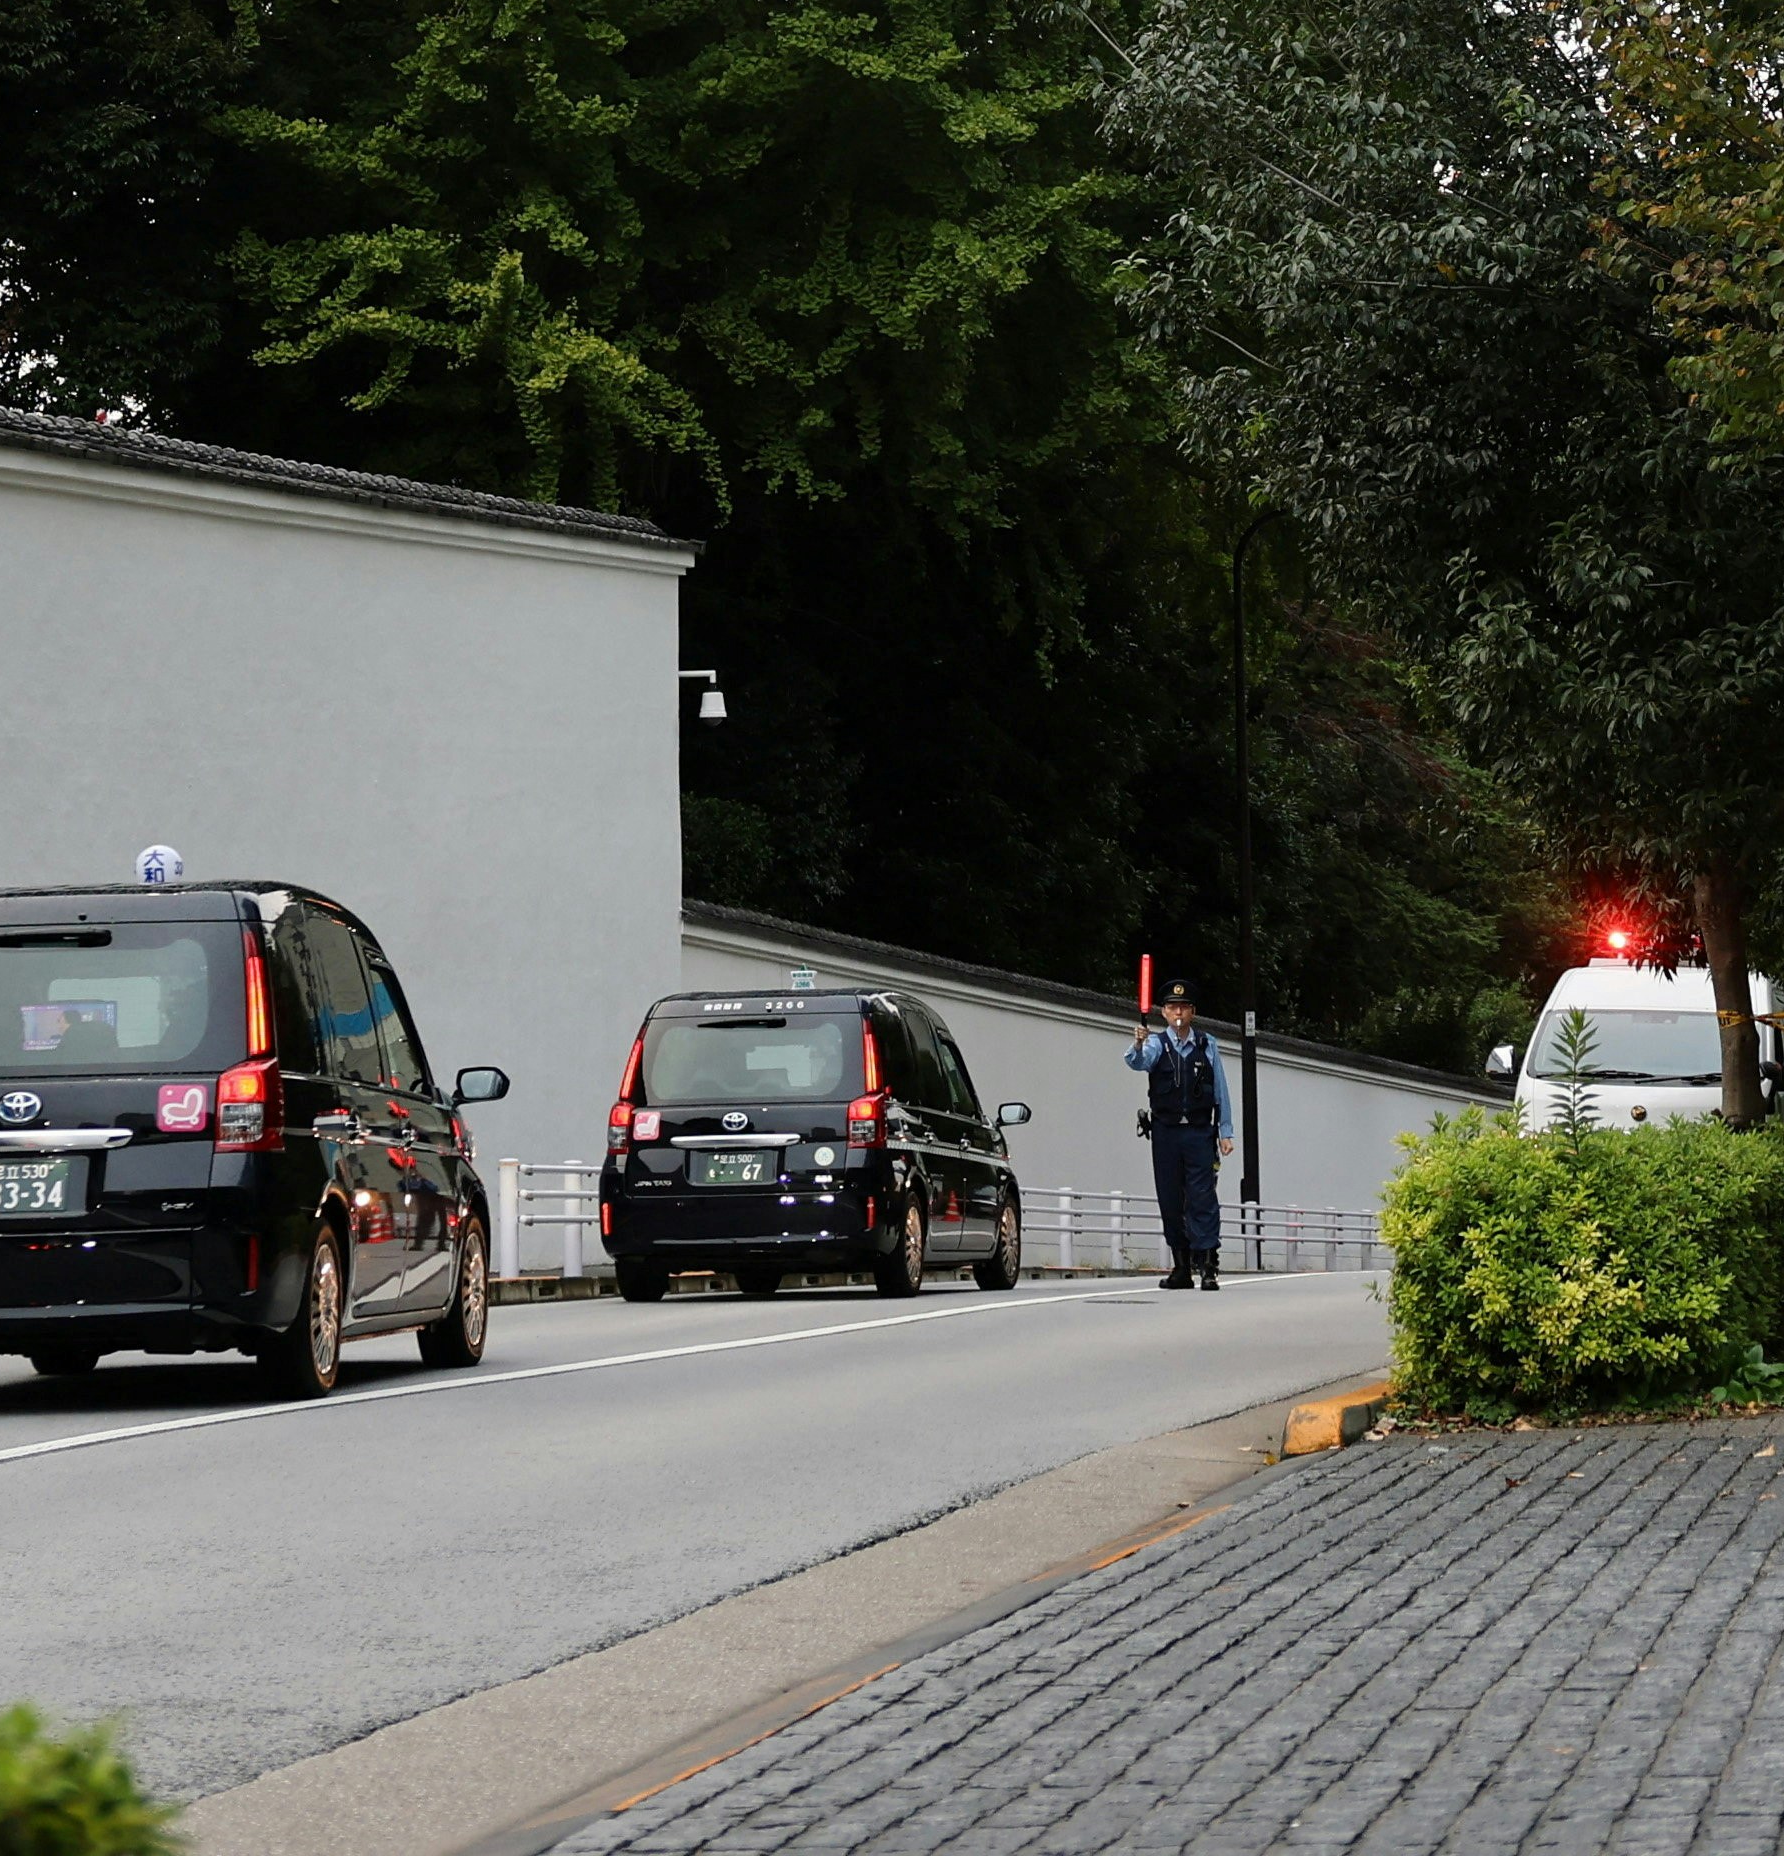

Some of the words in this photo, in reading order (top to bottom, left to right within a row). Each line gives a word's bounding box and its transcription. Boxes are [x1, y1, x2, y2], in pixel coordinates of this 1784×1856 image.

[143, 849, 165, 883] 大和
[765, 1000, 805, 1010] 3266
[21, 1164, 49, 1179] 530
